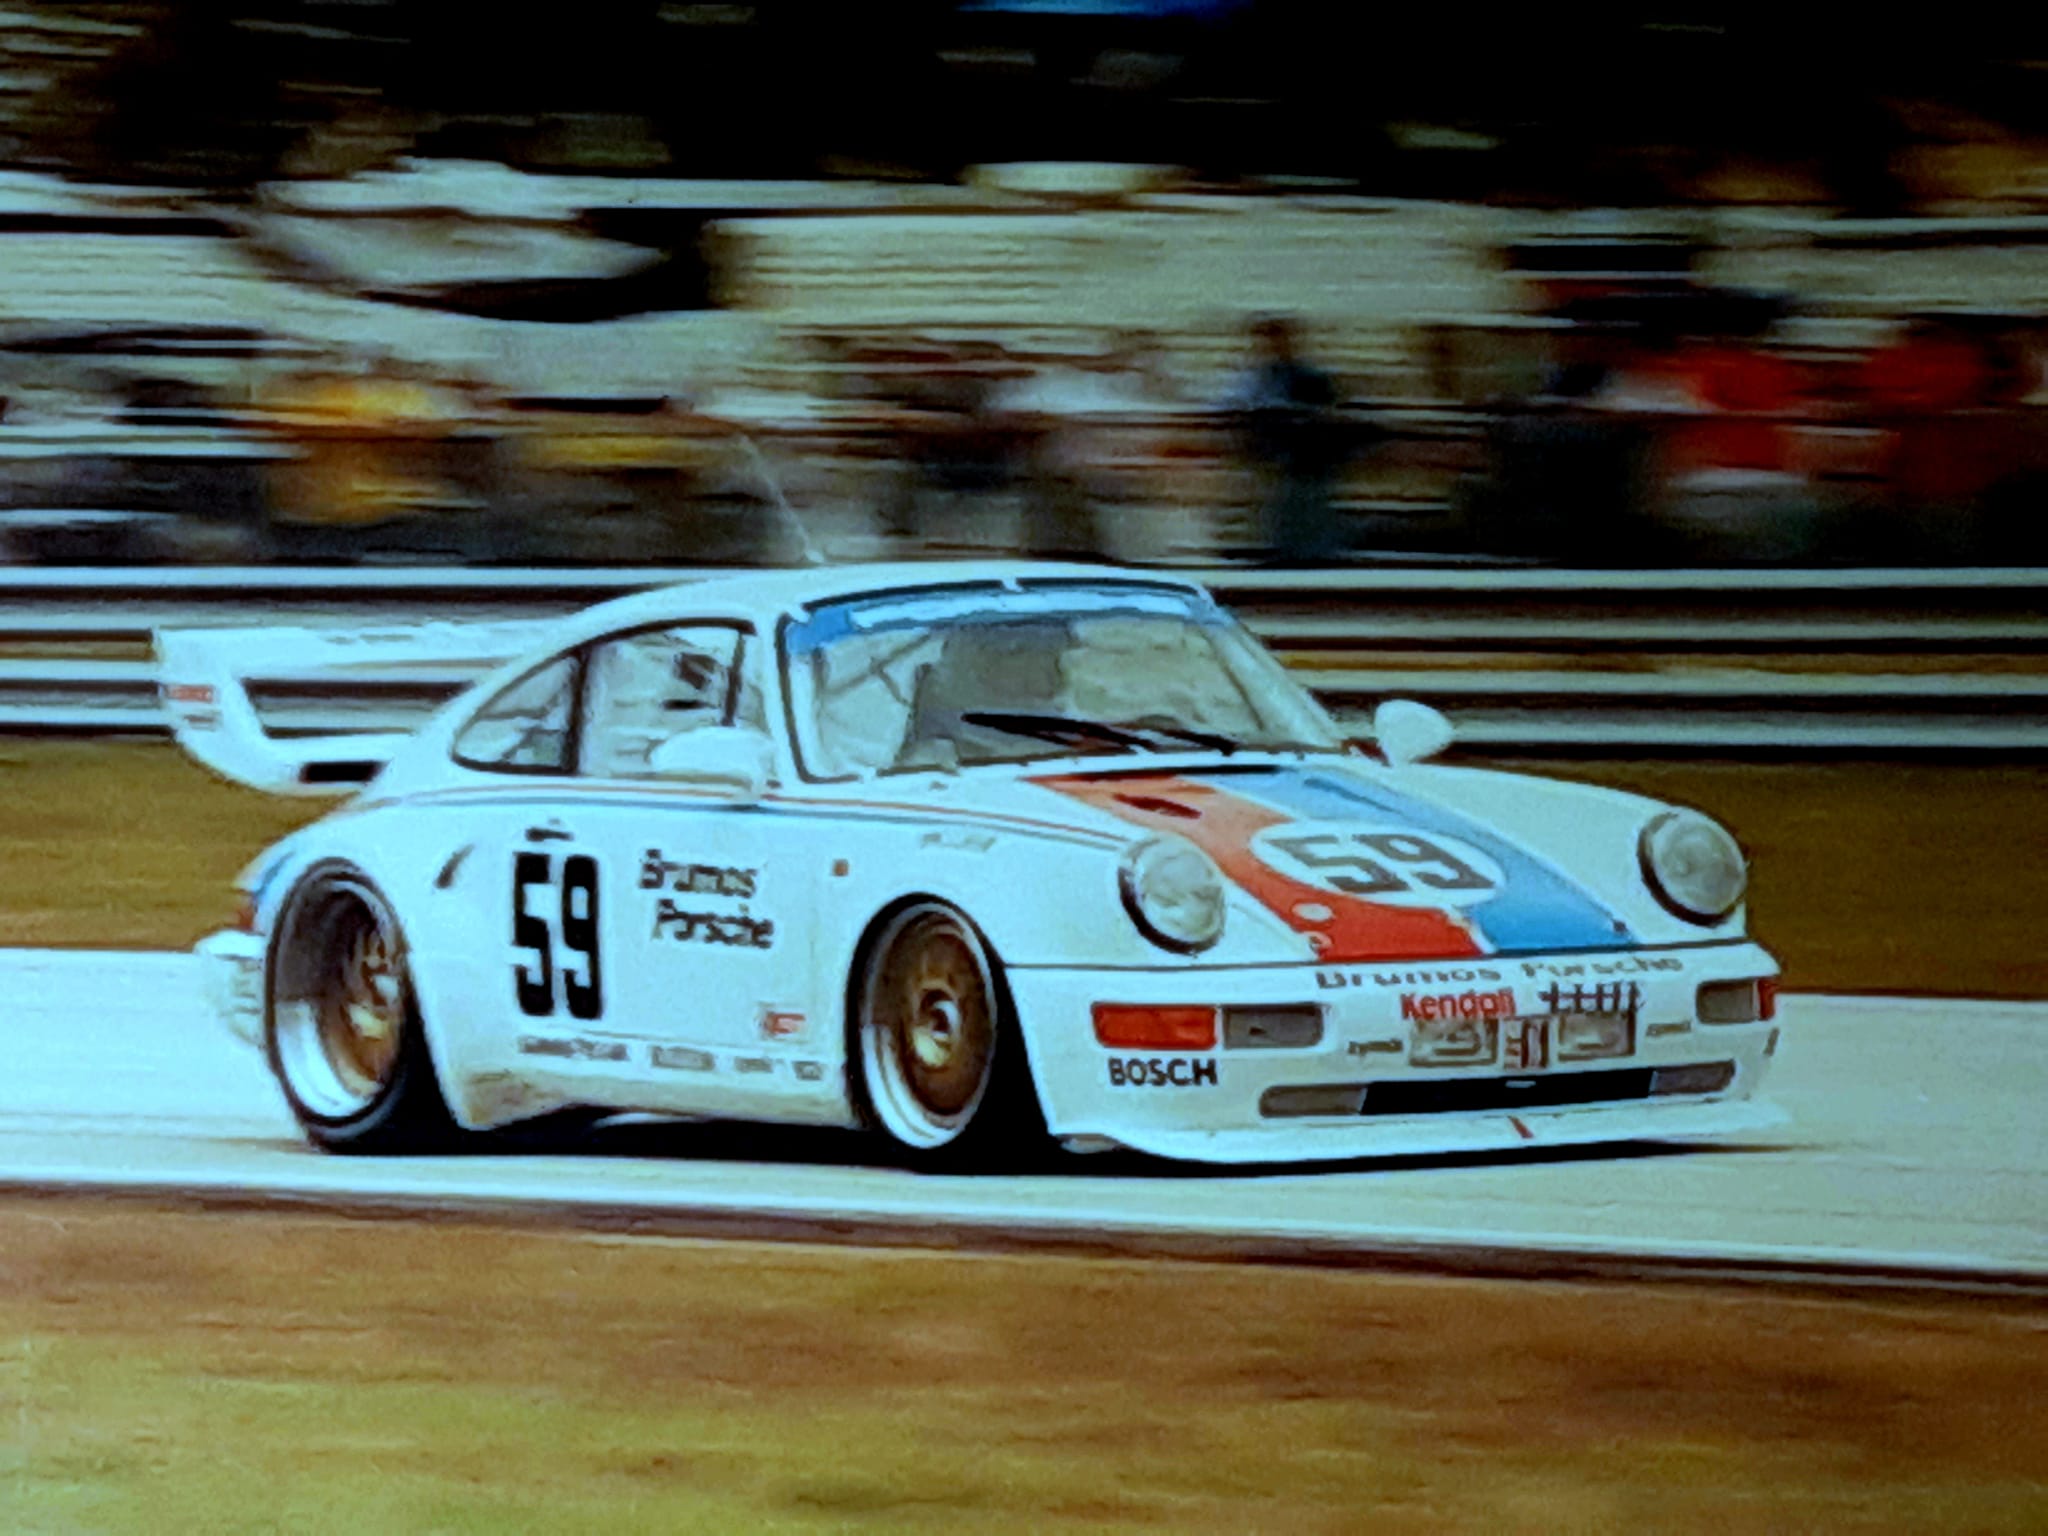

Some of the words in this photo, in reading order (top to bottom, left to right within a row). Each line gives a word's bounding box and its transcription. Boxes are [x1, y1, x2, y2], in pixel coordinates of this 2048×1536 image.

[1262, 834, 1496, 892] 59
[512, 851, 604, 1019] 59
[1108, 1058, 1218, 1086] BOSCH
